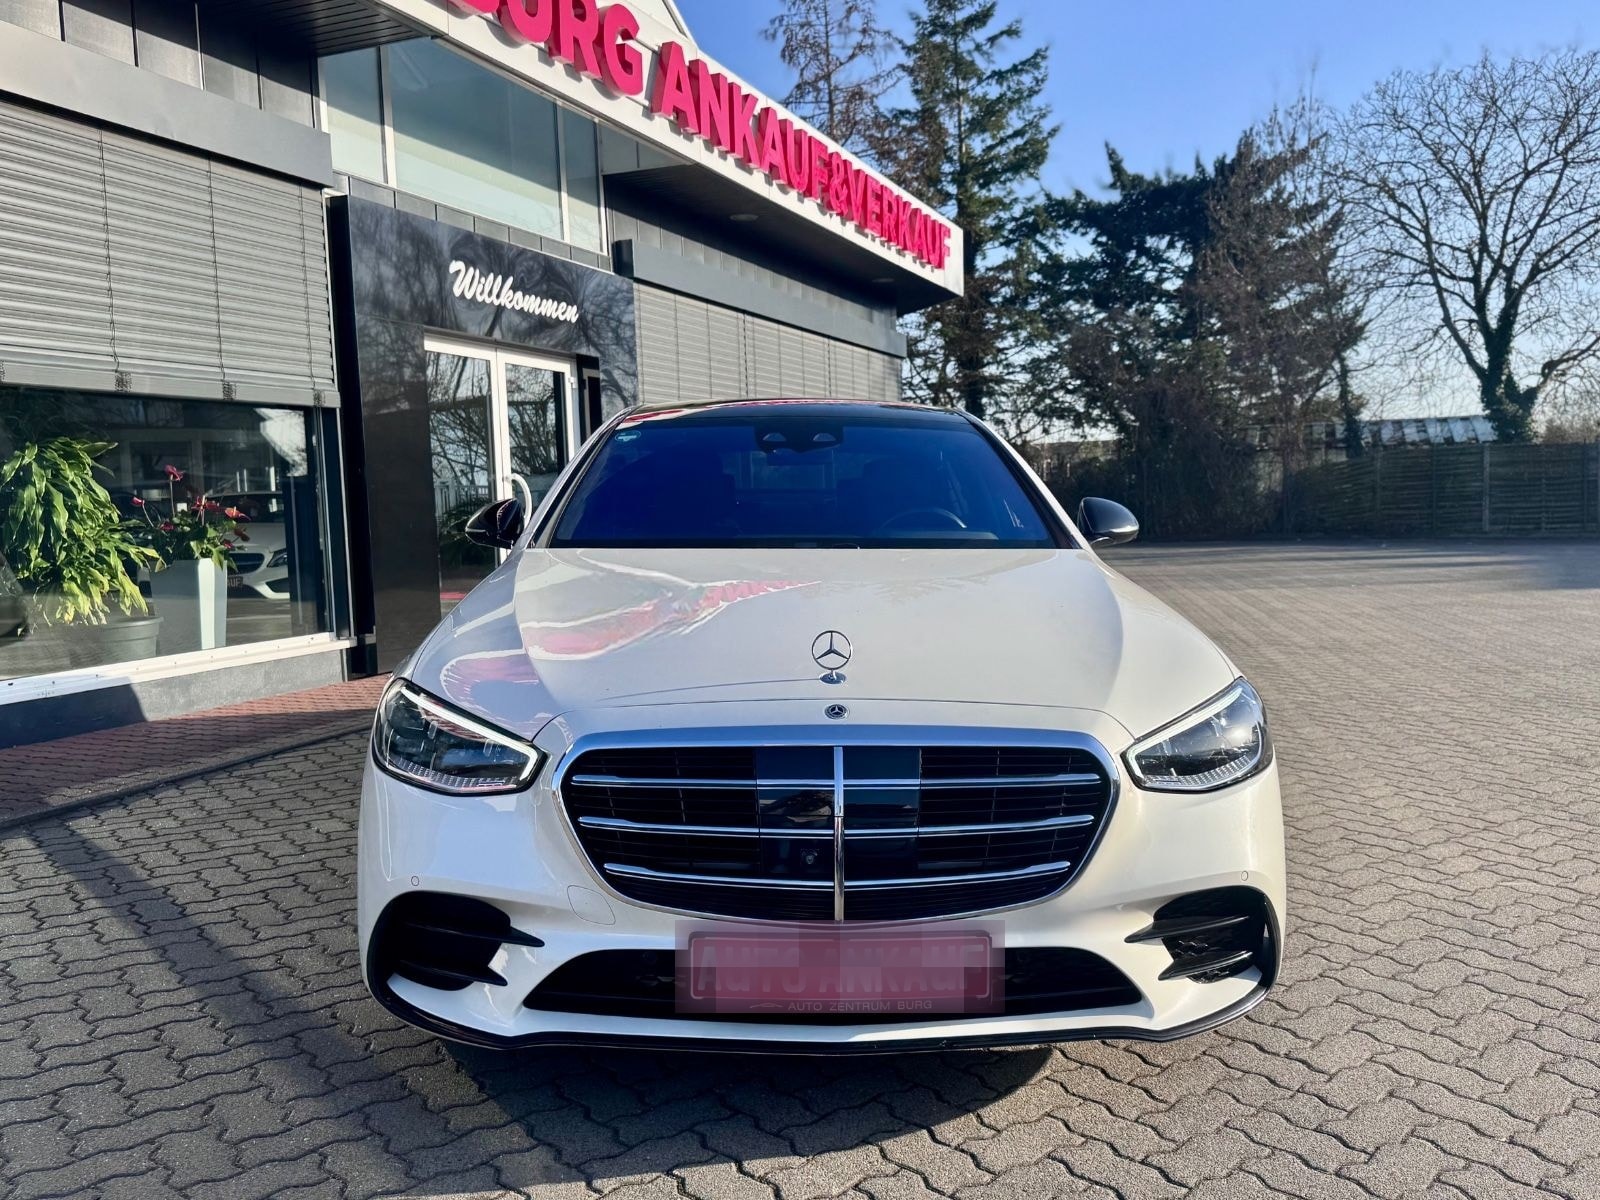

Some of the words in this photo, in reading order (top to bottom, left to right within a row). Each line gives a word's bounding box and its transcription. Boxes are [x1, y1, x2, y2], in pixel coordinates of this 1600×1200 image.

[456, 0, 644, 96] URG
[449, 260, 579, 323] Willkommen
[697, 946, 807, 992] AUTO
[819, 944, 984, 993] ANKAUF
[788, 1002, 823, 1012] AUTO
[829, 1001, 891, 1012] ZENTRUM
[897, 1000, 933, 1010] BURG
